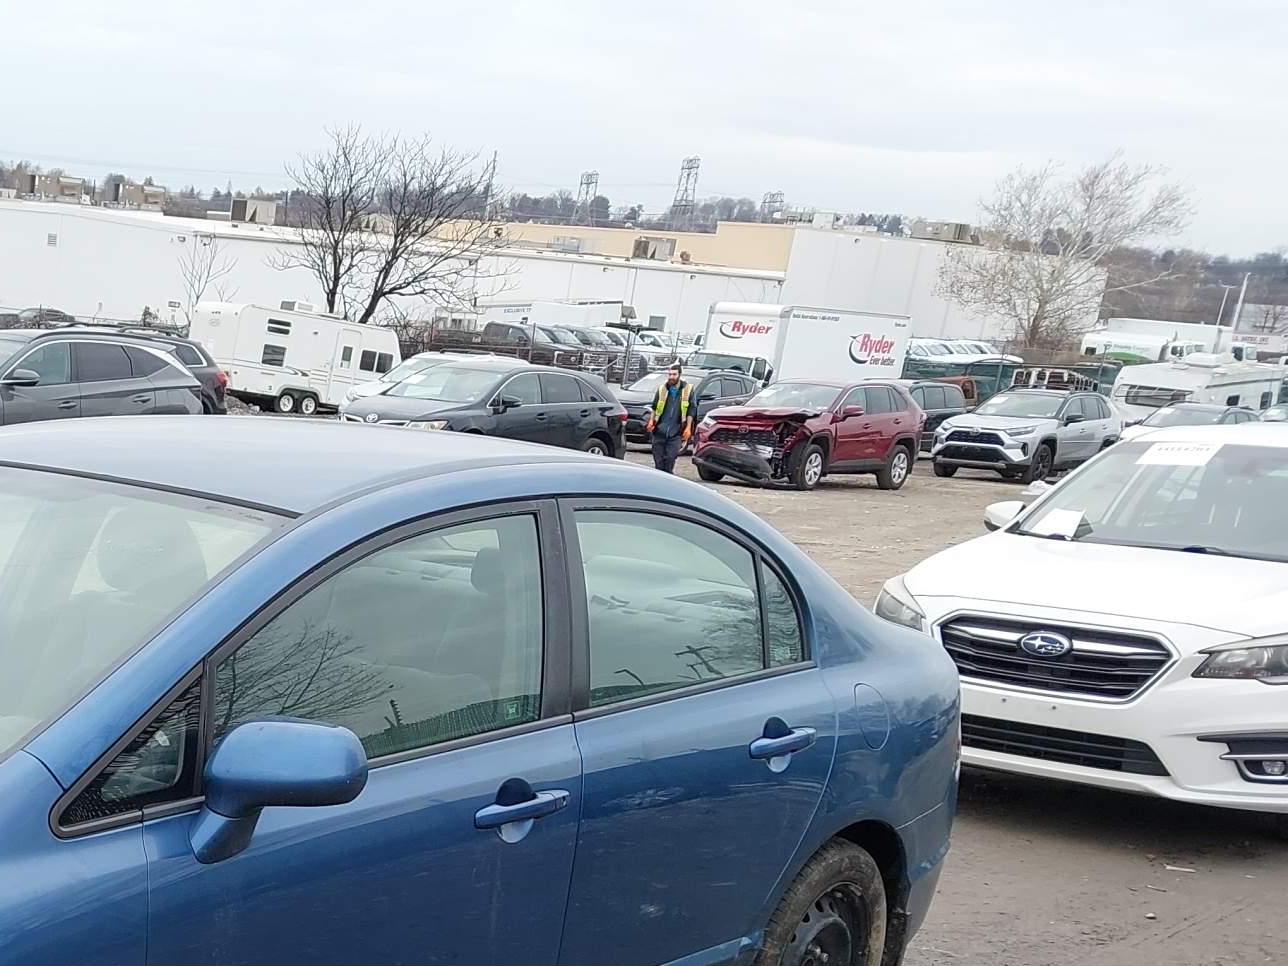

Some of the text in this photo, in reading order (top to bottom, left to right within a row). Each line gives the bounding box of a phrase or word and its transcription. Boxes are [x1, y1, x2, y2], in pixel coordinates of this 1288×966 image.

[731, 320, 773, 336] Ryder
[859, 333, 895, 357] Ryder
[869, 356, 880, 366] Ever
